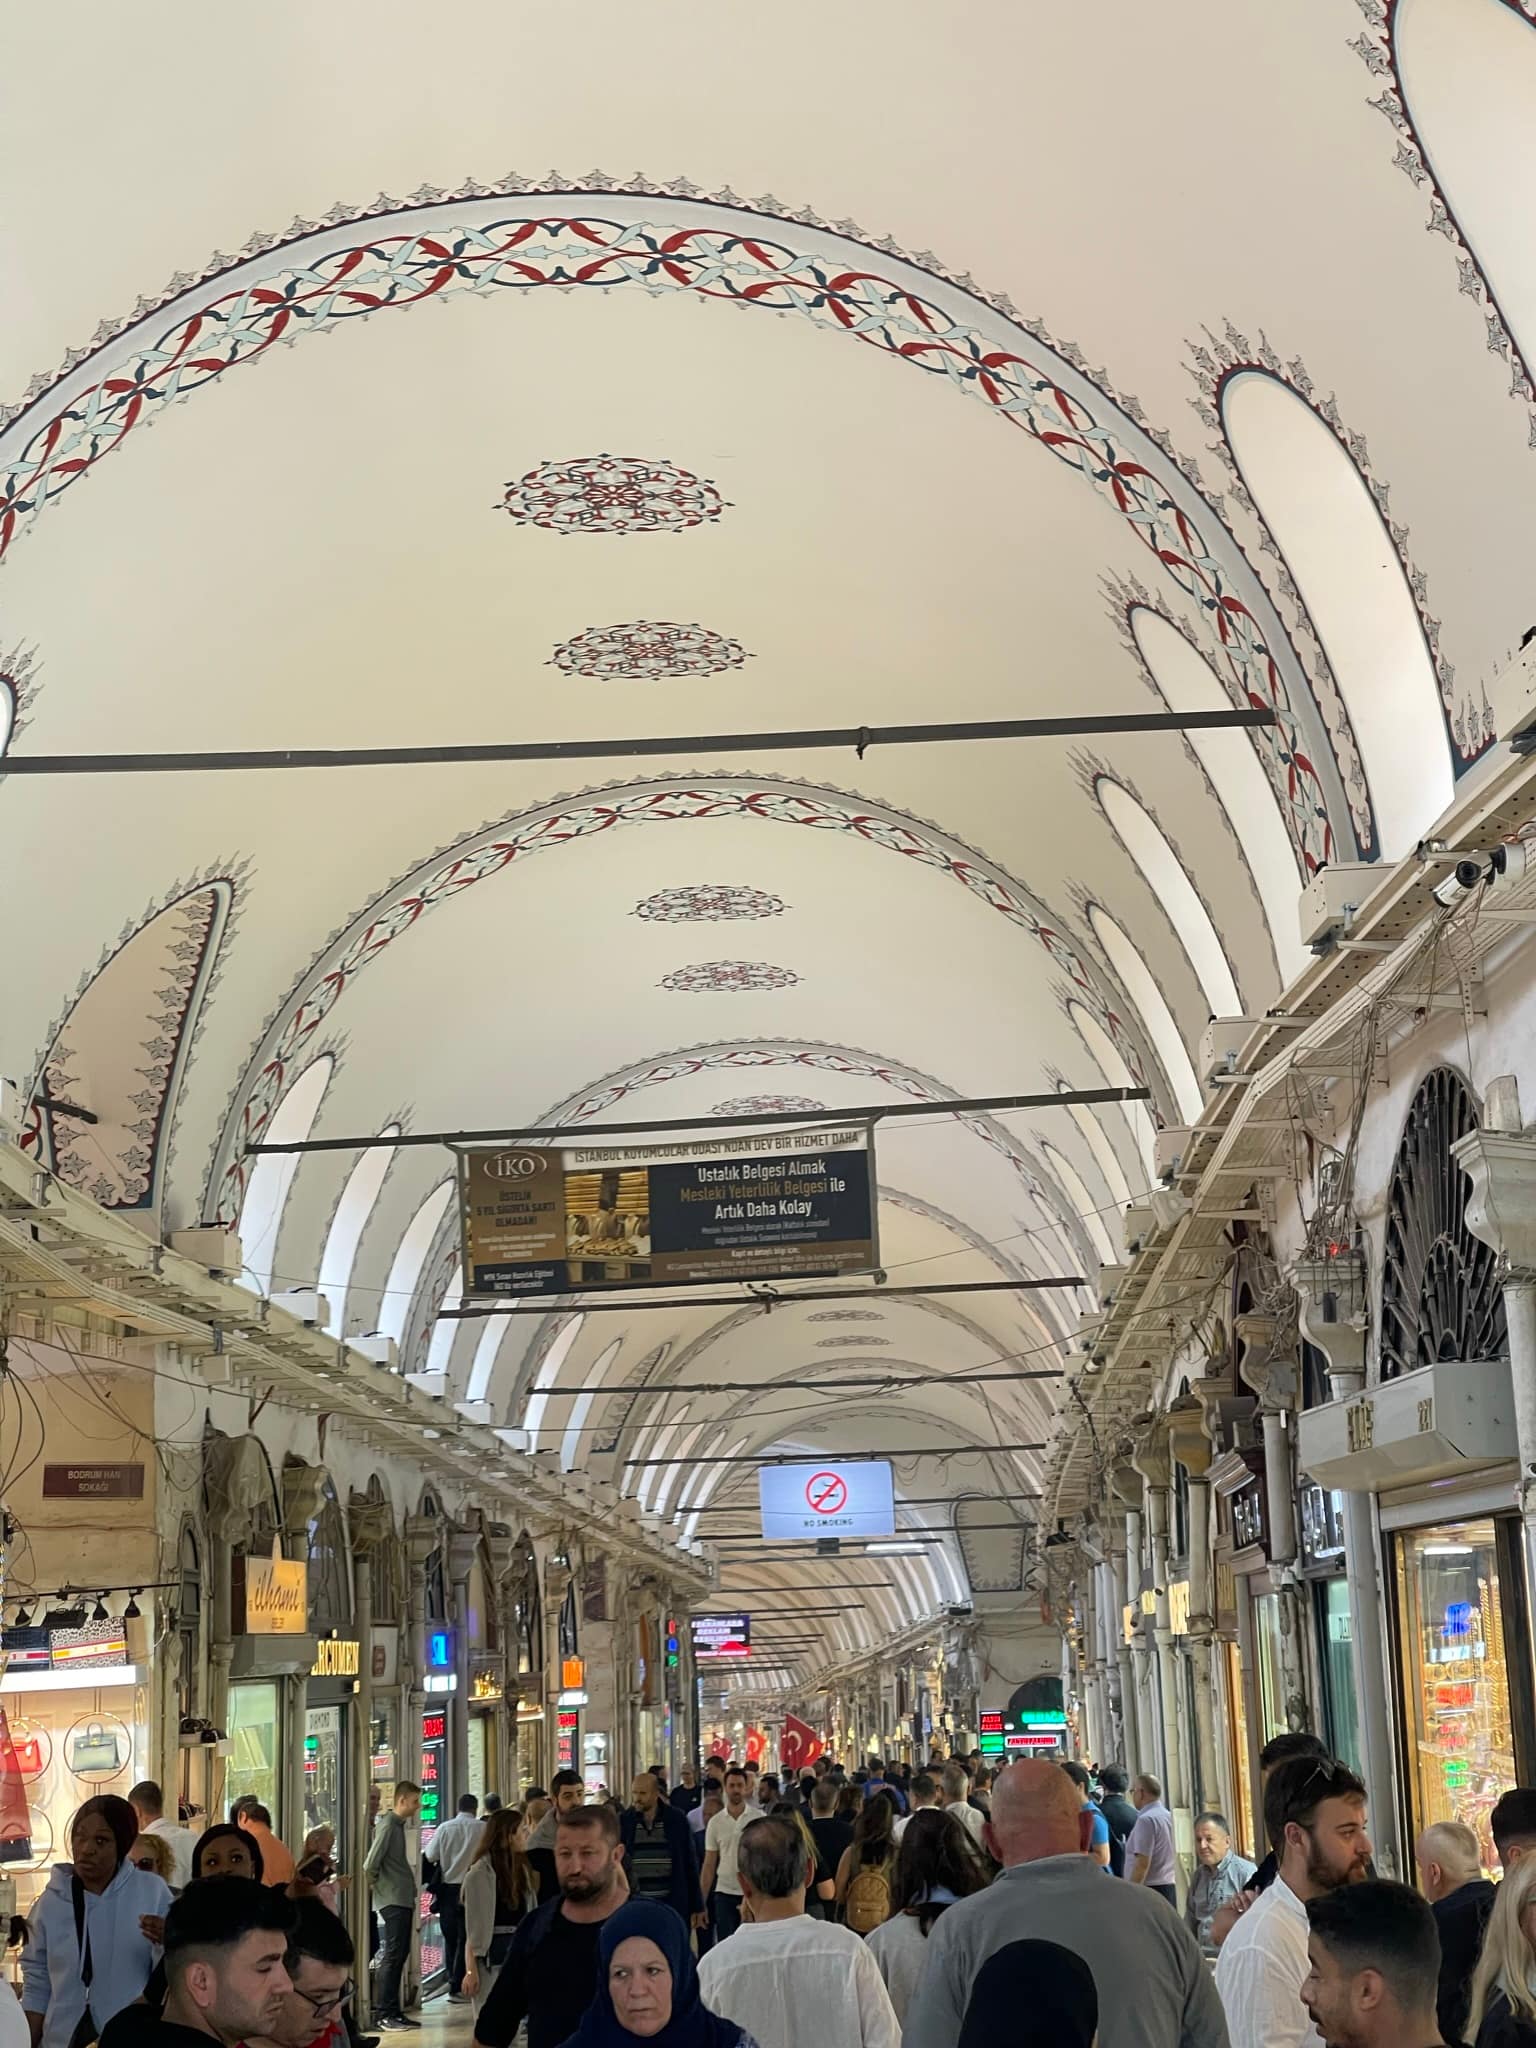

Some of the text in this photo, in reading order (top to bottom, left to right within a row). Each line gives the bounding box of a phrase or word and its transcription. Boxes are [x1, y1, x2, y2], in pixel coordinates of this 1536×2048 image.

[755, 1138, 774, 1151] DEV
[833, 1130, 858, 1145] DAHA
[497, 1156, 536, 1177] İKO
[698, 1160, 827, 1183] Ustalık Belgesi Almak
[680, 1177, 846, 1202] Mesleki Yeterlilik Belgesi ile
[715, 1200, 812, 1219] Artık Daha Kolay
[68, 1470, 121, 1480] BODRUM HAN
[803, 1518, 854, 1528] NO SMOKING
